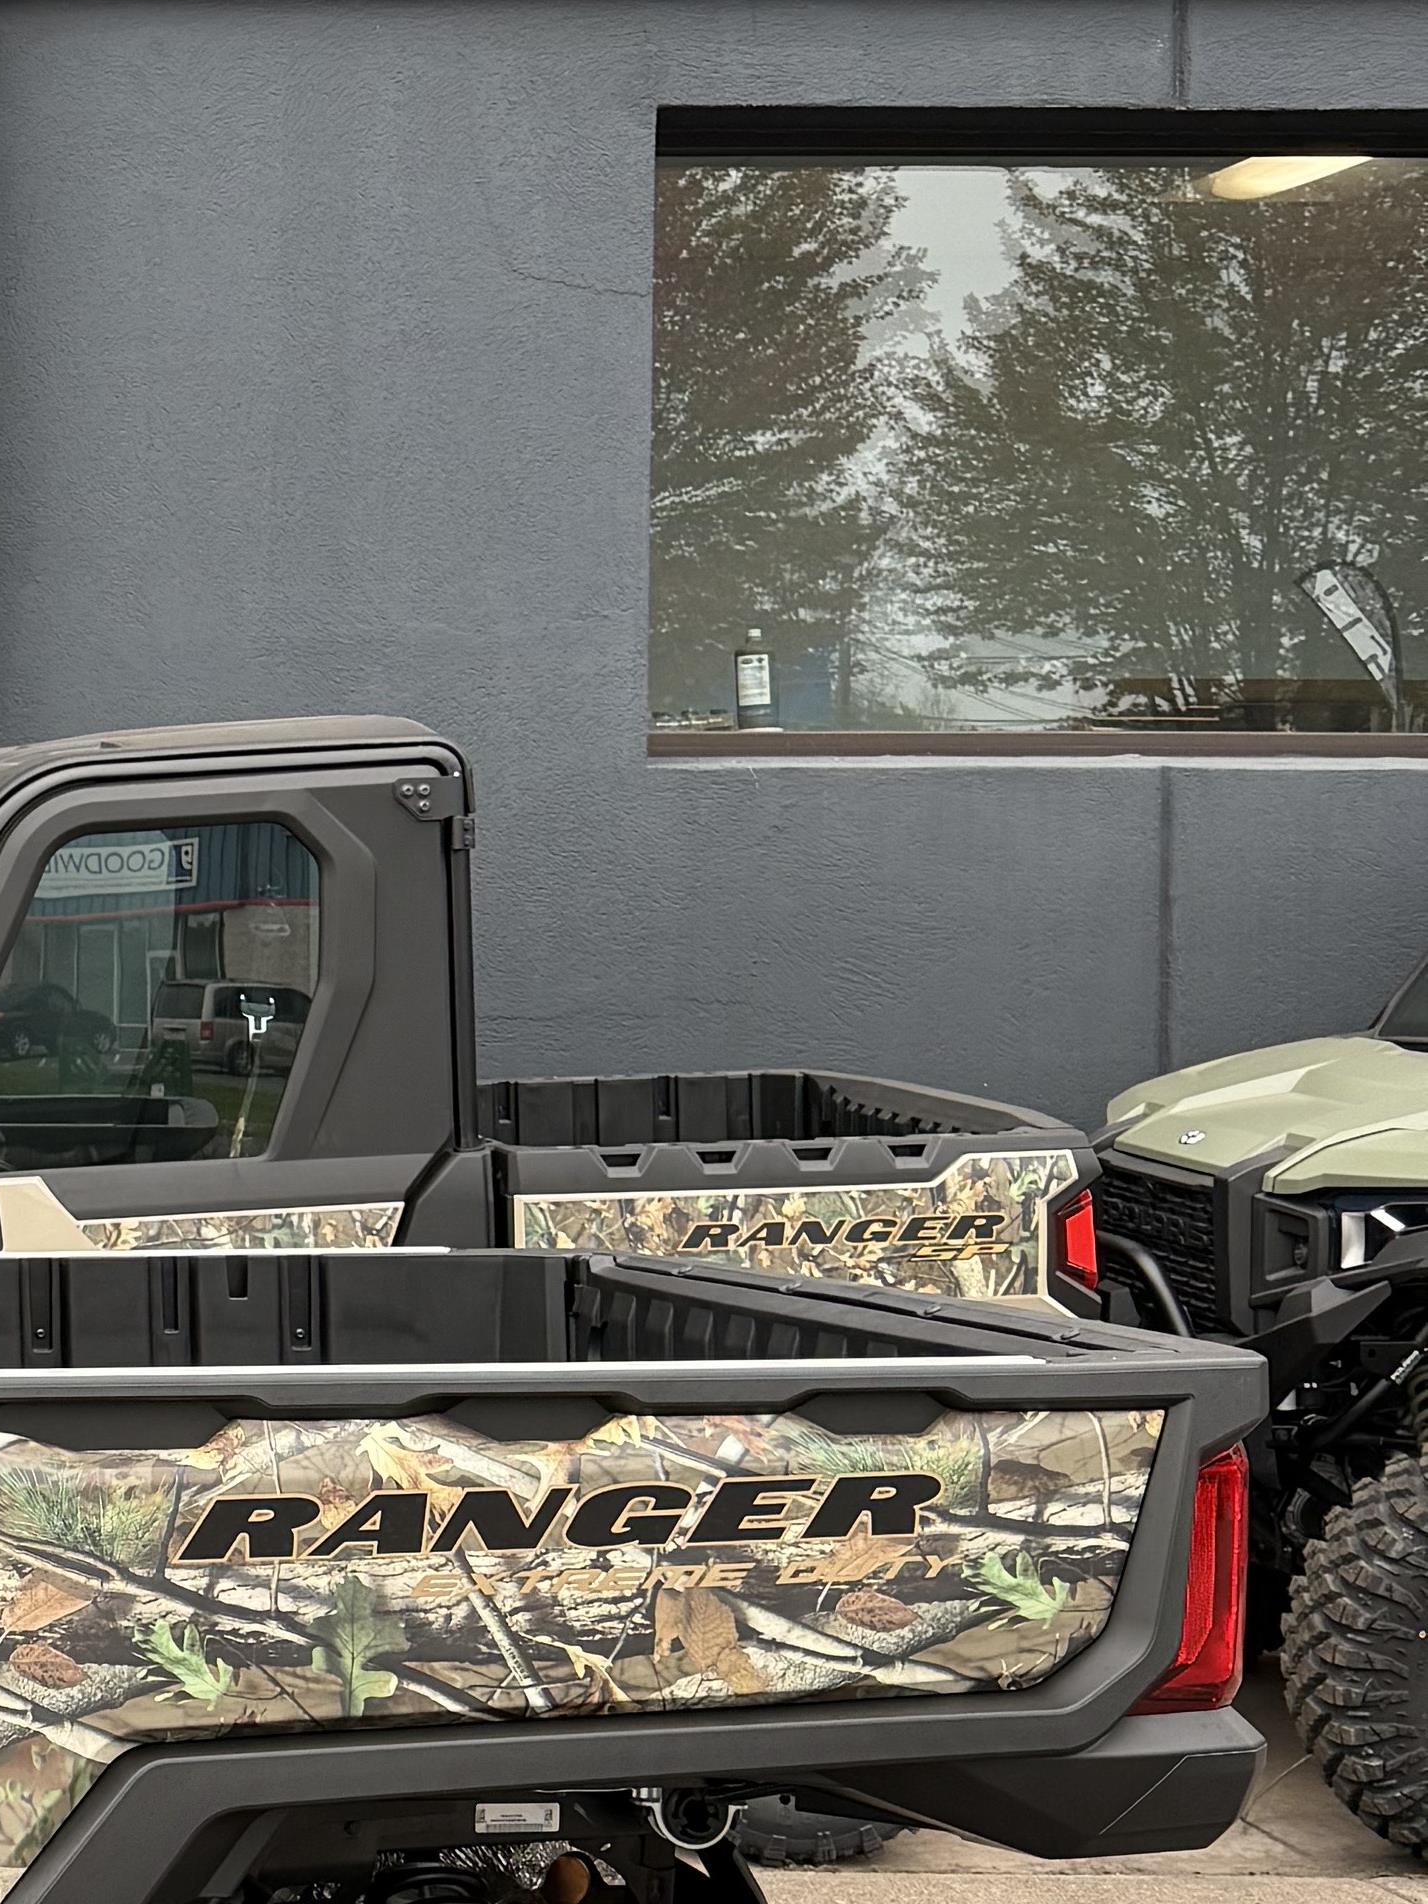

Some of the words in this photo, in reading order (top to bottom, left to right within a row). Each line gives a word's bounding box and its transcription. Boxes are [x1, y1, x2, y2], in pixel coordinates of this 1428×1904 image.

[677, 1212, 1006, 1252] RANGER
[909, 1242, 1011, 1262] SP
[172, 1470, 947, 1565] RANGER
[411, 1562, 756, 1598] EXTREME
[777, 1553, 966, 1586] DUTY
